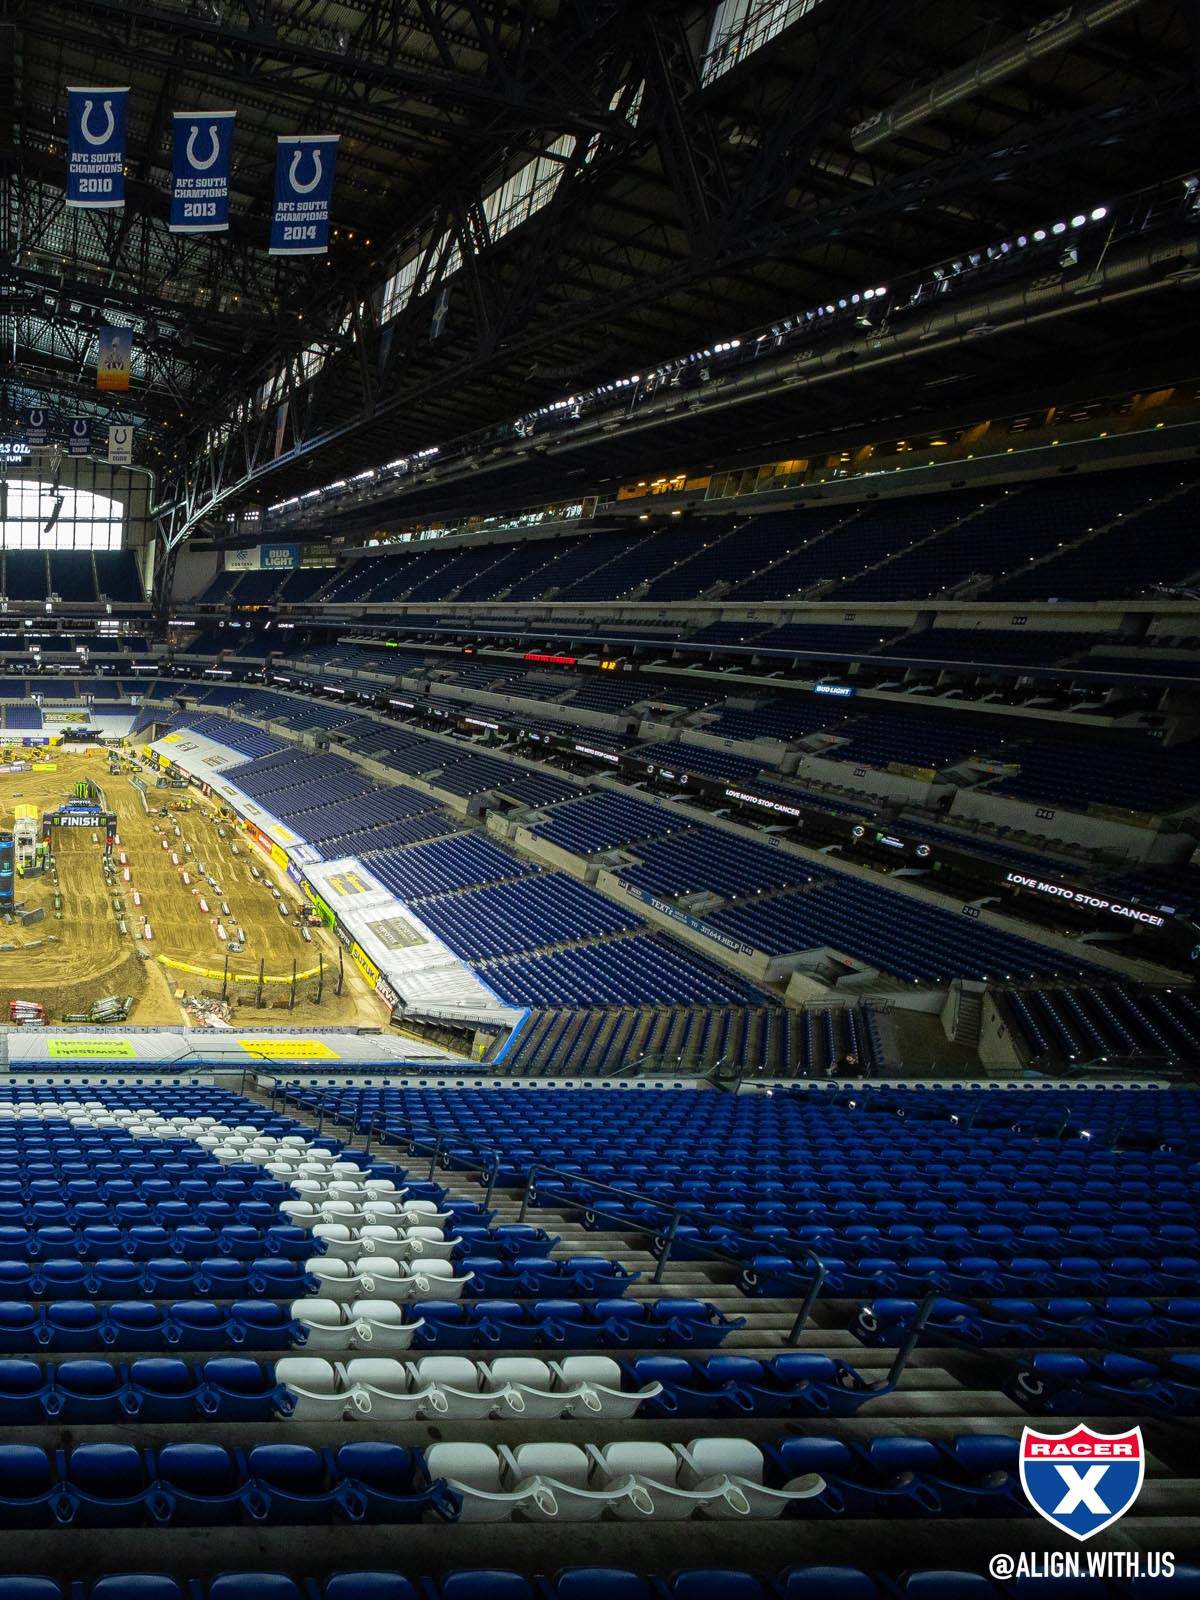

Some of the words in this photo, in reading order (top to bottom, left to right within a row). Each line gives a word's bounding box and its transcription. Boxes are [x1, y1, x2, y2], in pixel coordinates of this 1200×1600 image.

[71, 152, 89, 163] AFC
[91, 152, 122, 163] SOUTH
[69, 163, 123, 174] CHAMPIONS
[79, 178, 112, 193] 2010
[176, 178, 194, 188] AFC
[195, 177, 227, 188] SOUTH
[174, 187, 228, 199] CHAMPIONS
[183, 202, 216, 217] 2013
[277, 201, 295, 212] AFC
[297, 200, 327, 211] SOUTH
[275, 211, 328, 222] CHAMPIONS
[283, 225, 316, 240] 2014
[13, 443, 31, 454] OIL
[269, 550, 289, 558] BUD
[265, 557, 293, 566] LIGHT
[816, 685, 831, 693] BUD
[832, 687, 850, 695] LIGHT
[726, 790, 741, 800] LOVE
[741, 793, 757, 805] MOTO
[758, 798, 773, 810] STOP
[773, 803, 800, 817] CANCER
[60, 816, 100, 827] FINISH
[1007, 873, 1036, 889] LOVE
[1037, 882, 1073, 899] MOTO
[1074, 894, 1109, 909] STOP
[651, 899, 670, 914] TEXT
[963, 905, 979, 917] 245
